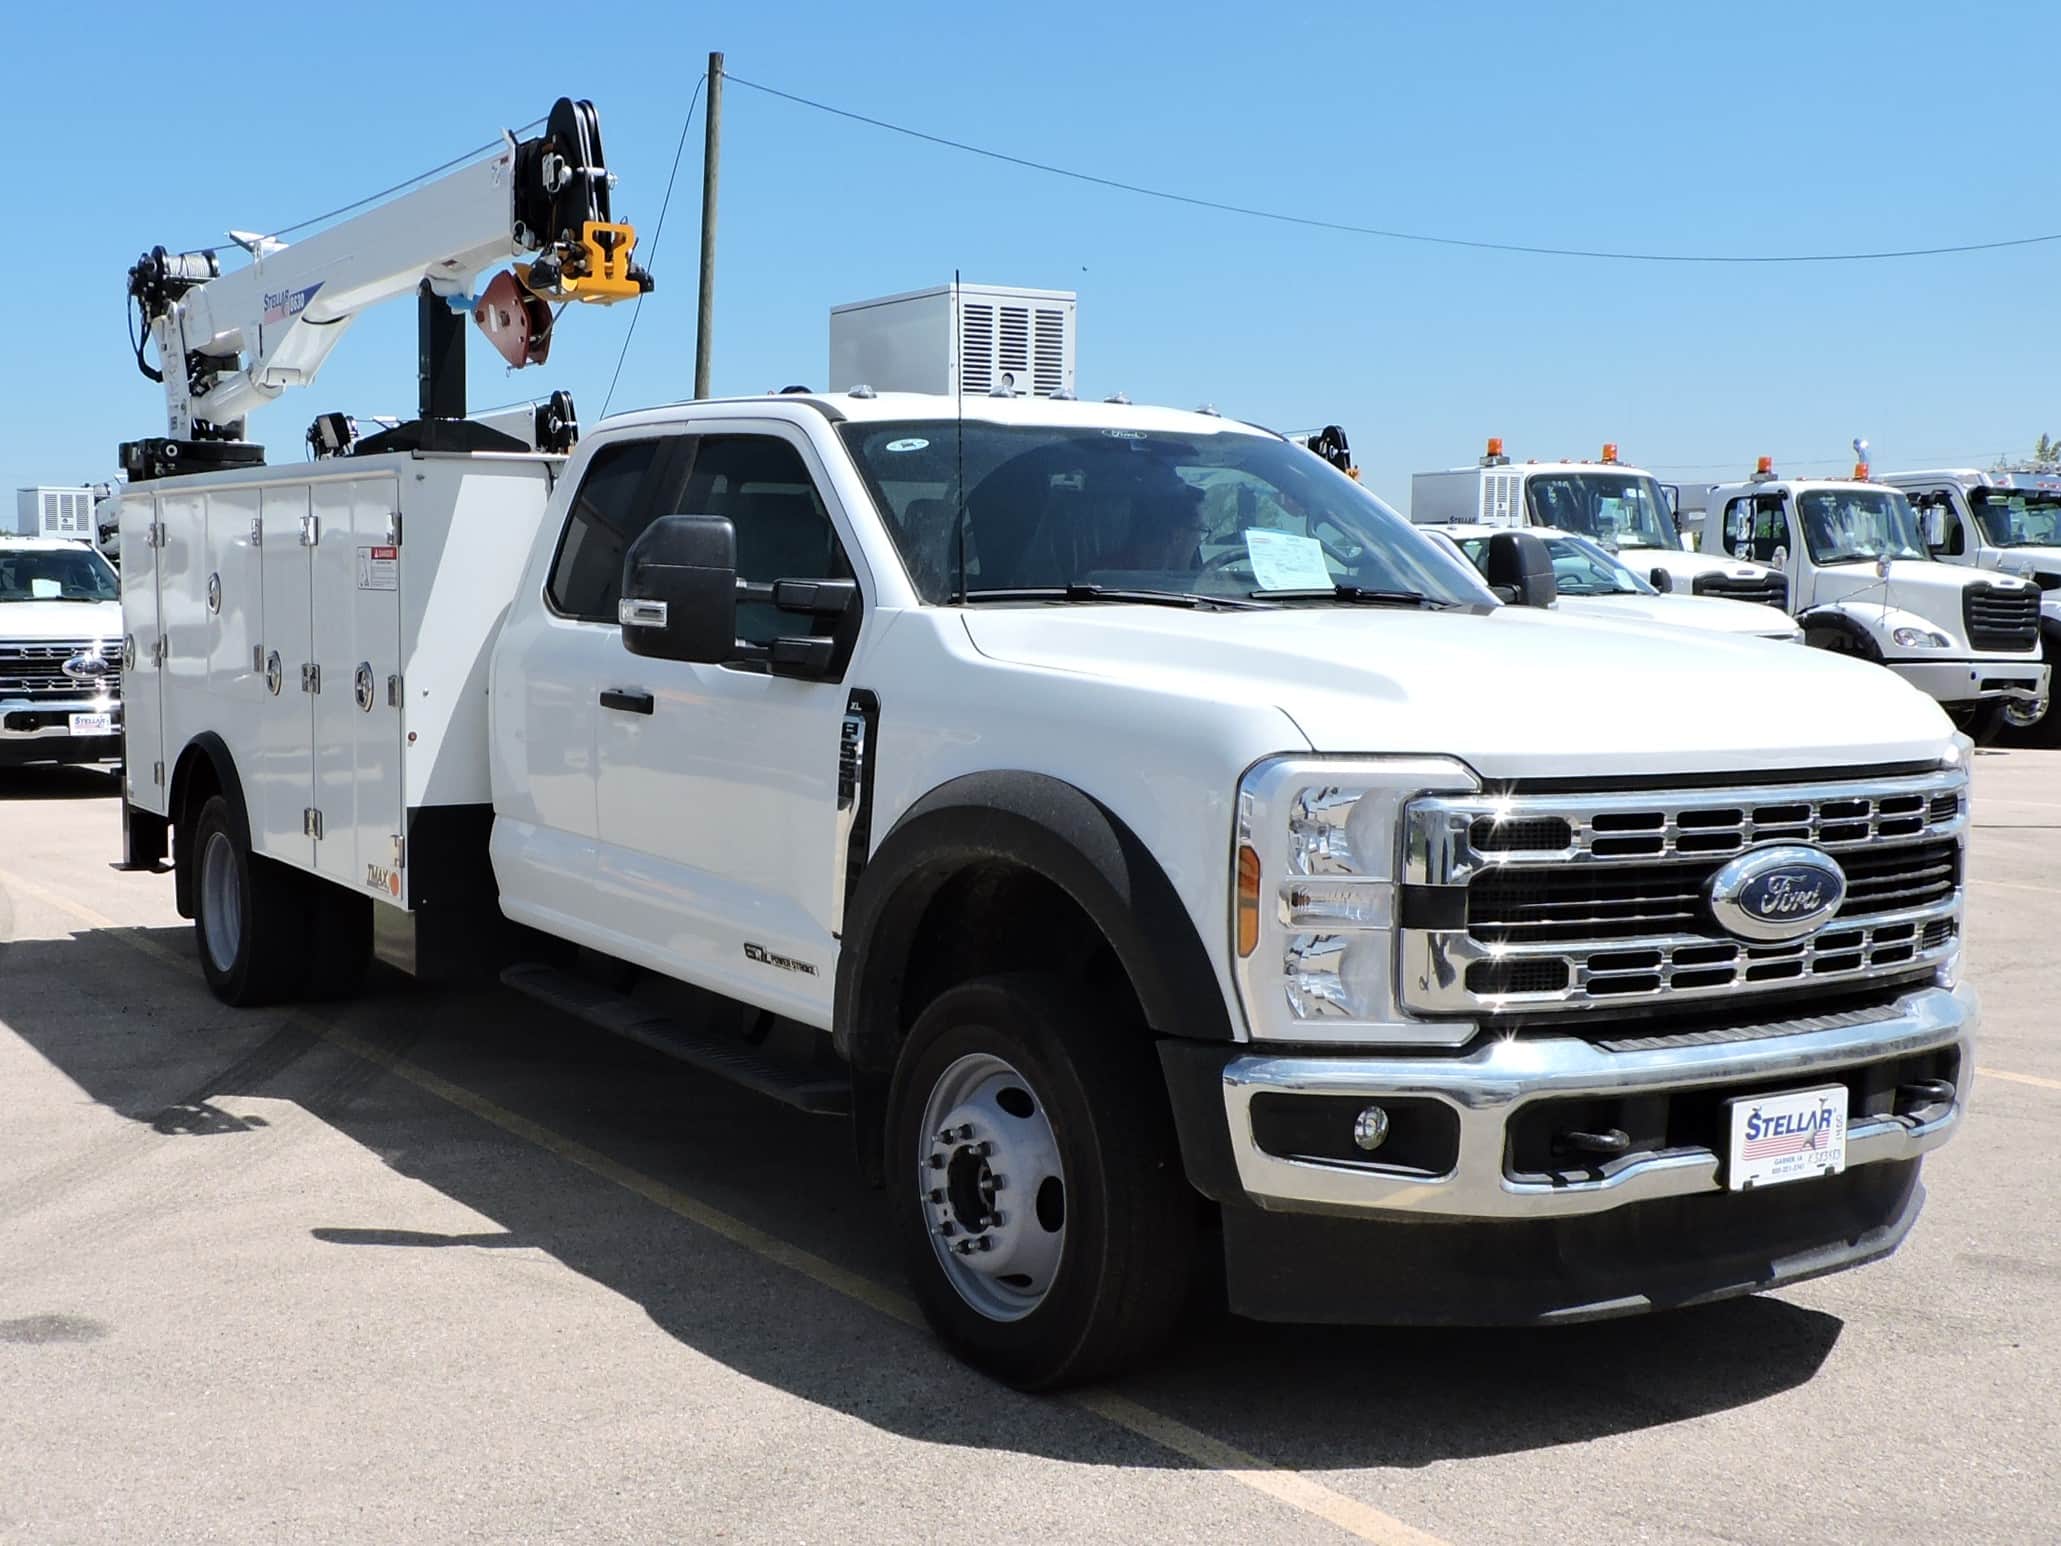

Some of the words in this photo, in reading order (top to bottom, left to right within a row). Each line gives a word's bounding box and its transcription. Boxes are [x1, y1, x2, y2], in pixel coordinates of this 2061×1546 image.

[850, 702, 862, 710] XL
[1761, 874, 1822, 914] Ford
[1745, 1107, 1833, 1141] STELLAR
